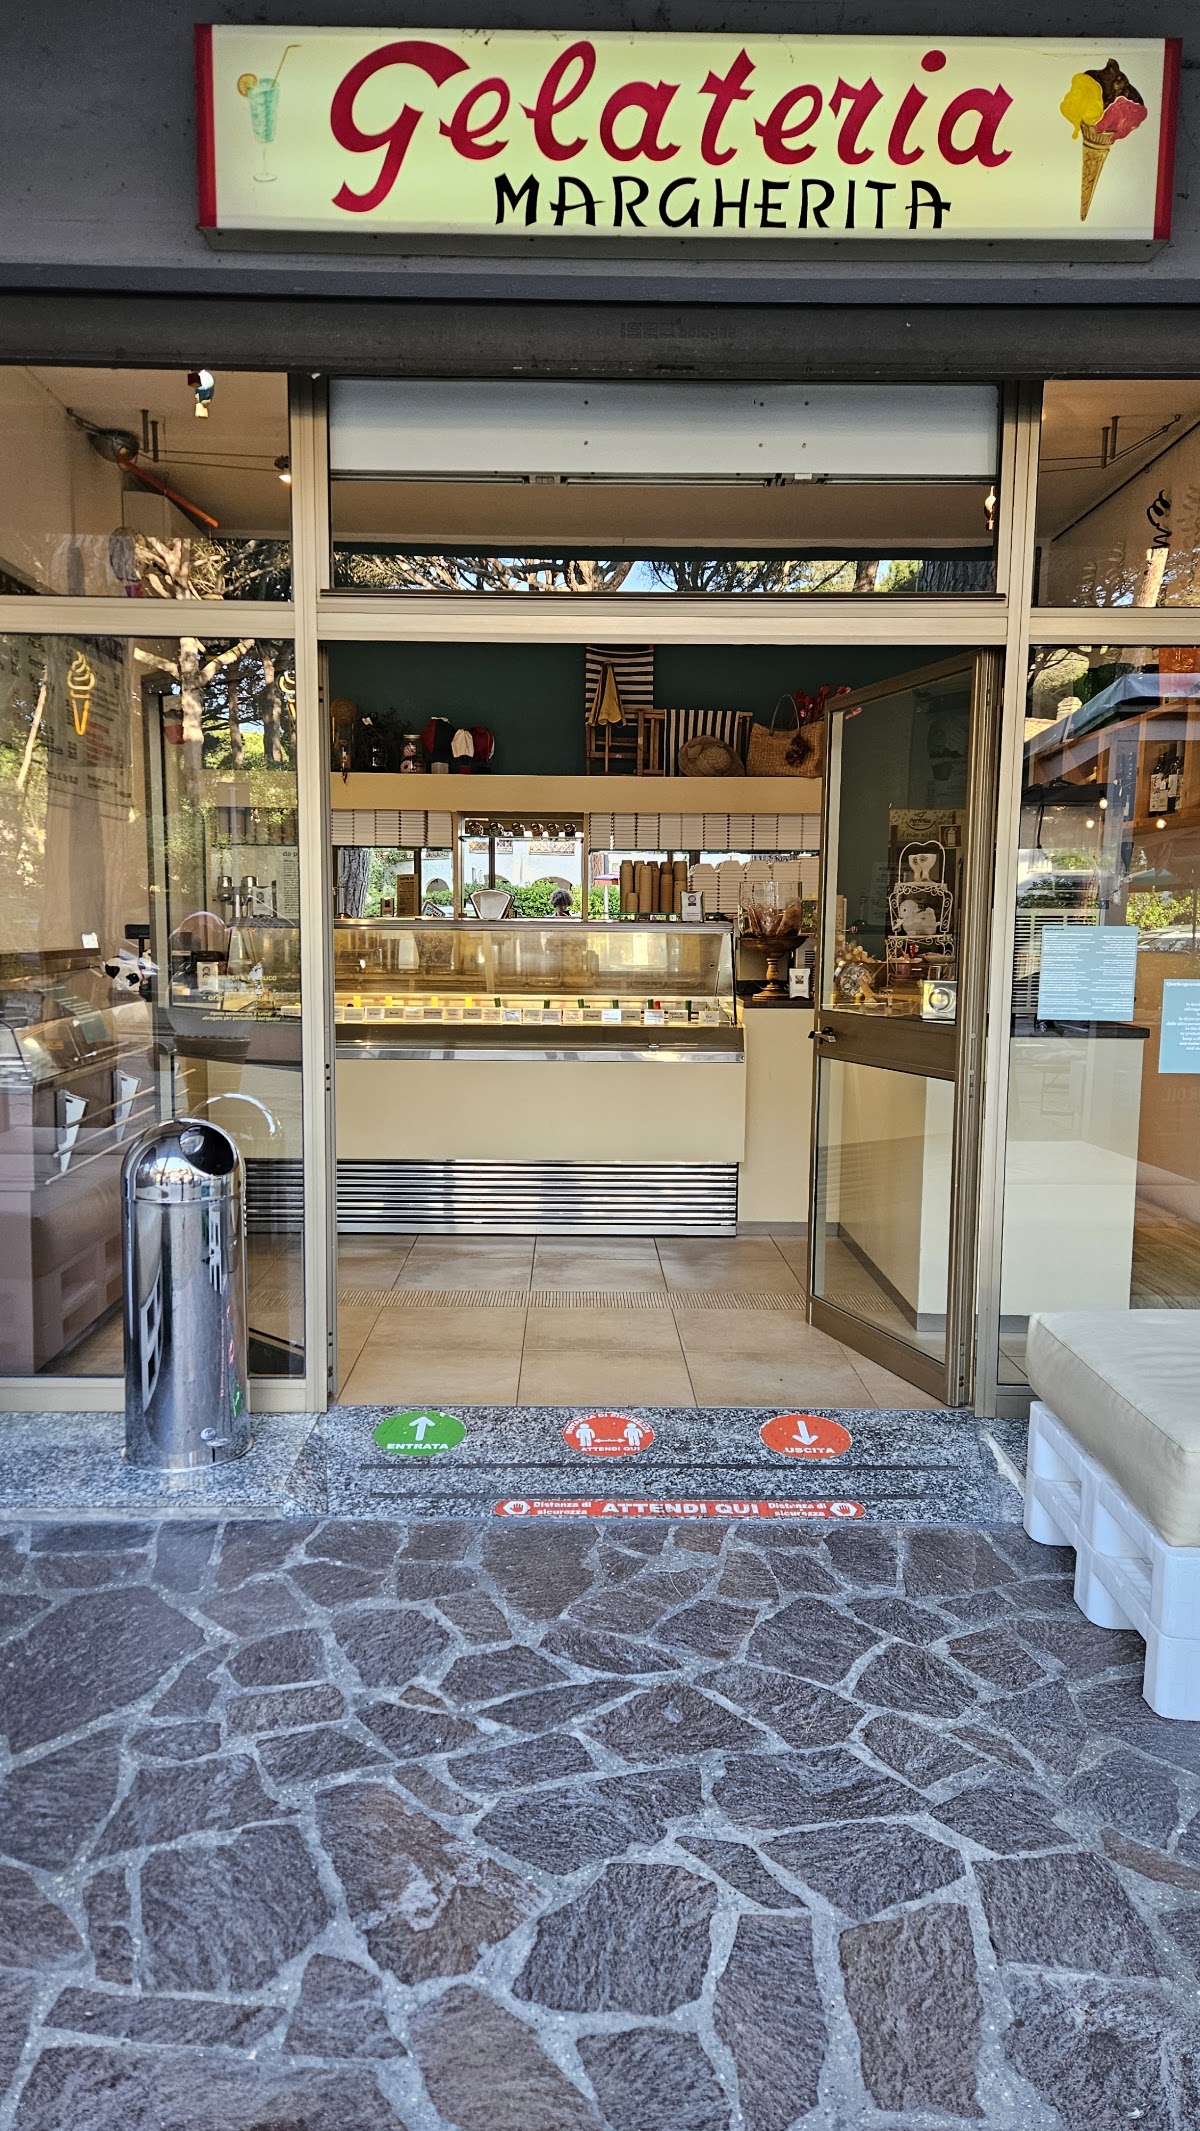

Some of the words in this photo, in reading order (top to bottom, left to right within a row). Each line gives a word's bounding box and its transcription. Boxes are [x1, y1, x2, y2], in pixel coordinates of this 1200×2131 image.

[330, 40, 1014, 213] Gelateria
[494, 173, 952, 230] MARGHERITA
[565, 1413, 597, 1434] DISTANZA
[610, 1412, 651, 1433] SICUREZZA
[602, 1503, 707, 1514] ATTENDI
[715, 1503, 759, 1514] QUI
